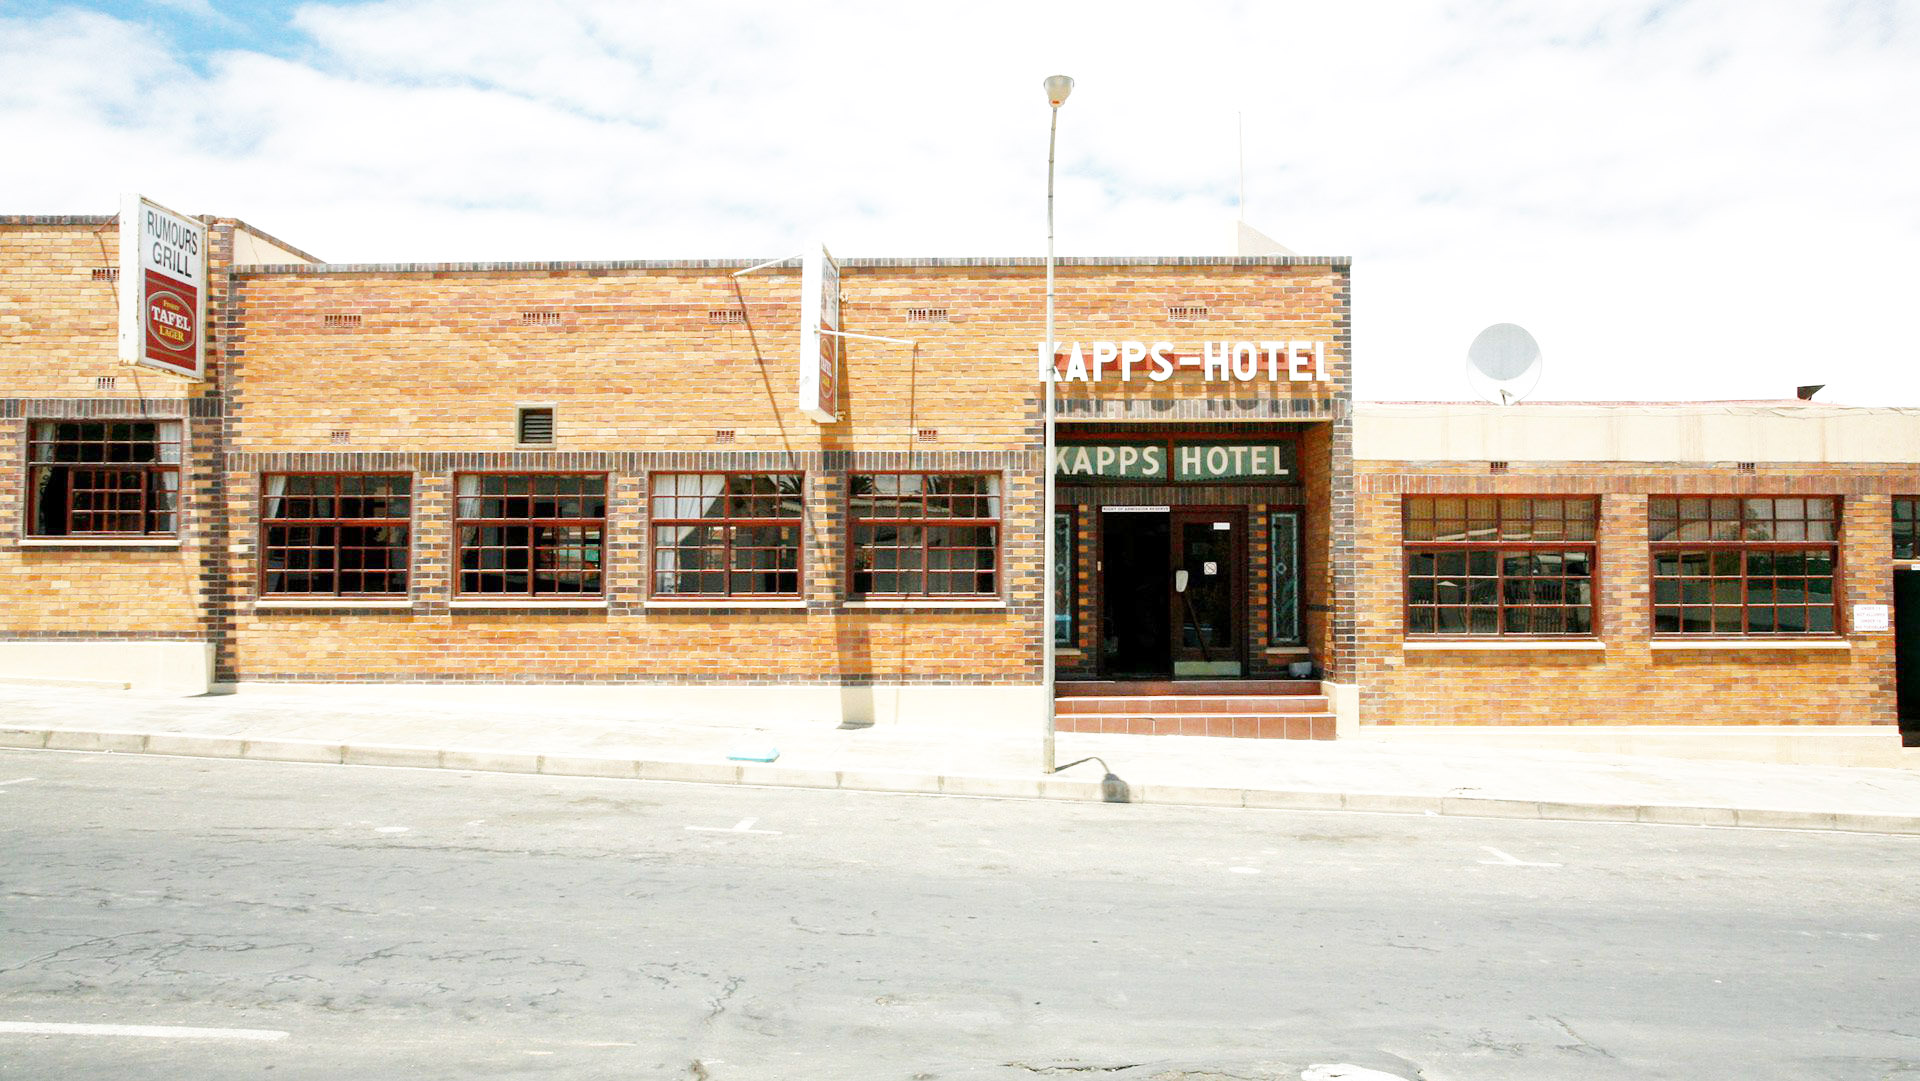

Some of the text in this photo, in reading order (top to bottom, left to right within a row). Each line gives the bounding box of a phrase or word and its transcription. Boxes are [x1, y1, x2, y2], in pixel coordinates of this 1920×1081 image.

[147, 210, 198, 255] RUMOURS
[152, 241, 192, 278] GRILL
[151, 305, 191, 332] TAFEL
[1054, 445, 1289, 476] KAPPS HOTEL
